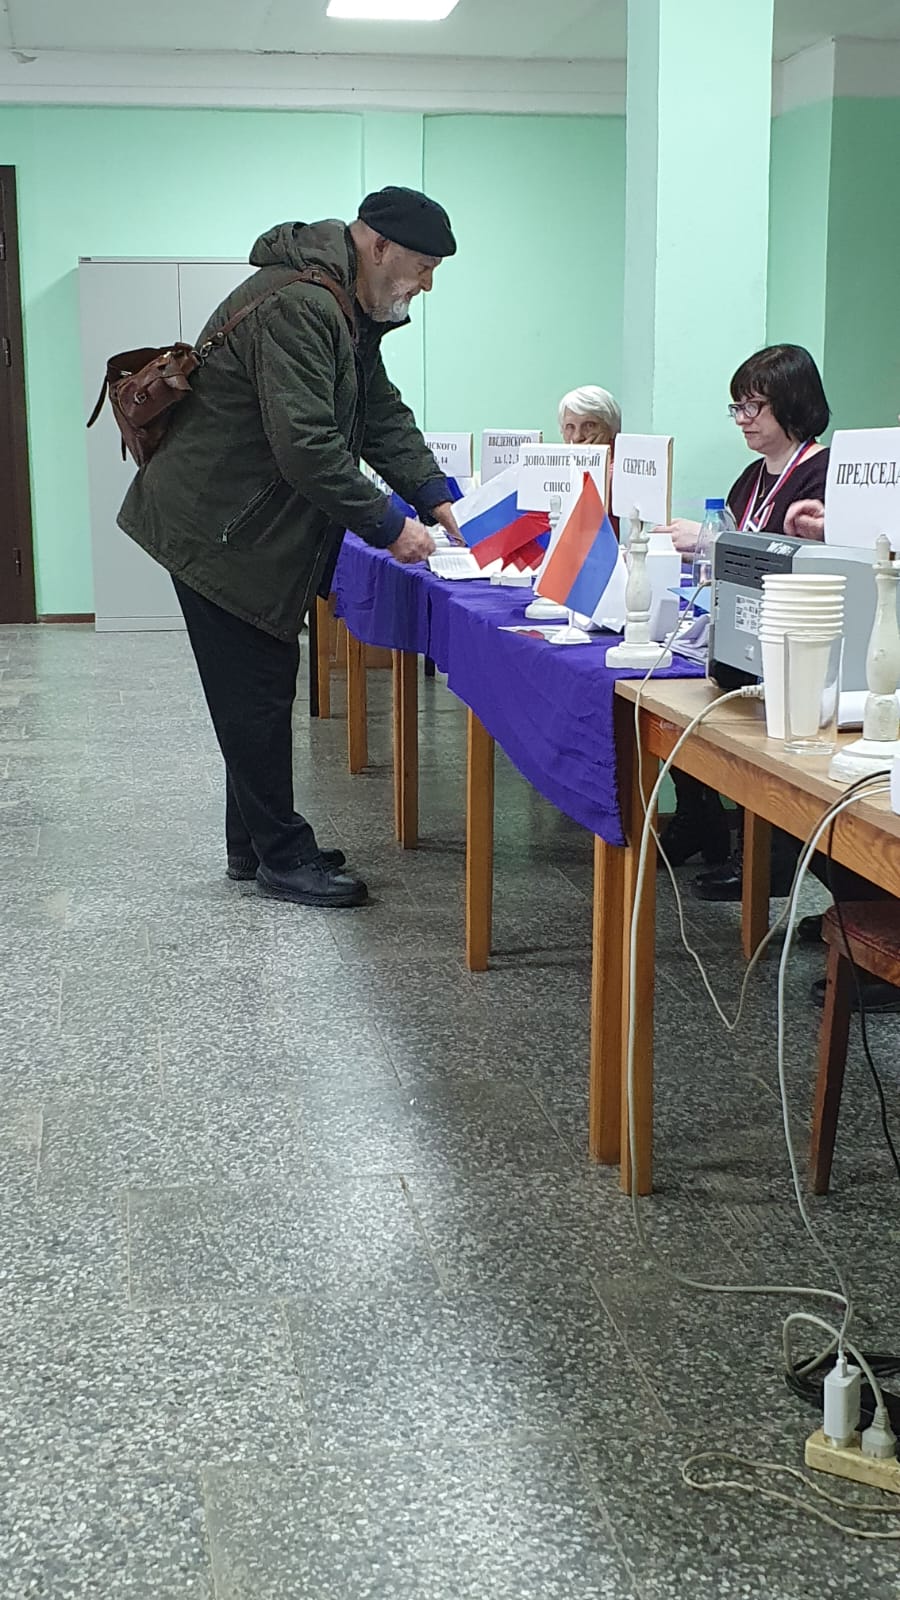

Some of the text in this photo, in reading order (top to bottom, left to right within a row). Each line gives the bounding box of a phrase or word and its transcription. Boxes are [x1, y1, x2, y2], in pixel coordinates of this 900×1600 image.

[427, 441, 457, 451] НСКОГО
[522, 452, 601, 467] ДОПОЛНИТЕЬНЫЙ
[622, 458, 657, 477] СЕКРЕТАРЬ
[543, 481, 571, 493] СПИСО
